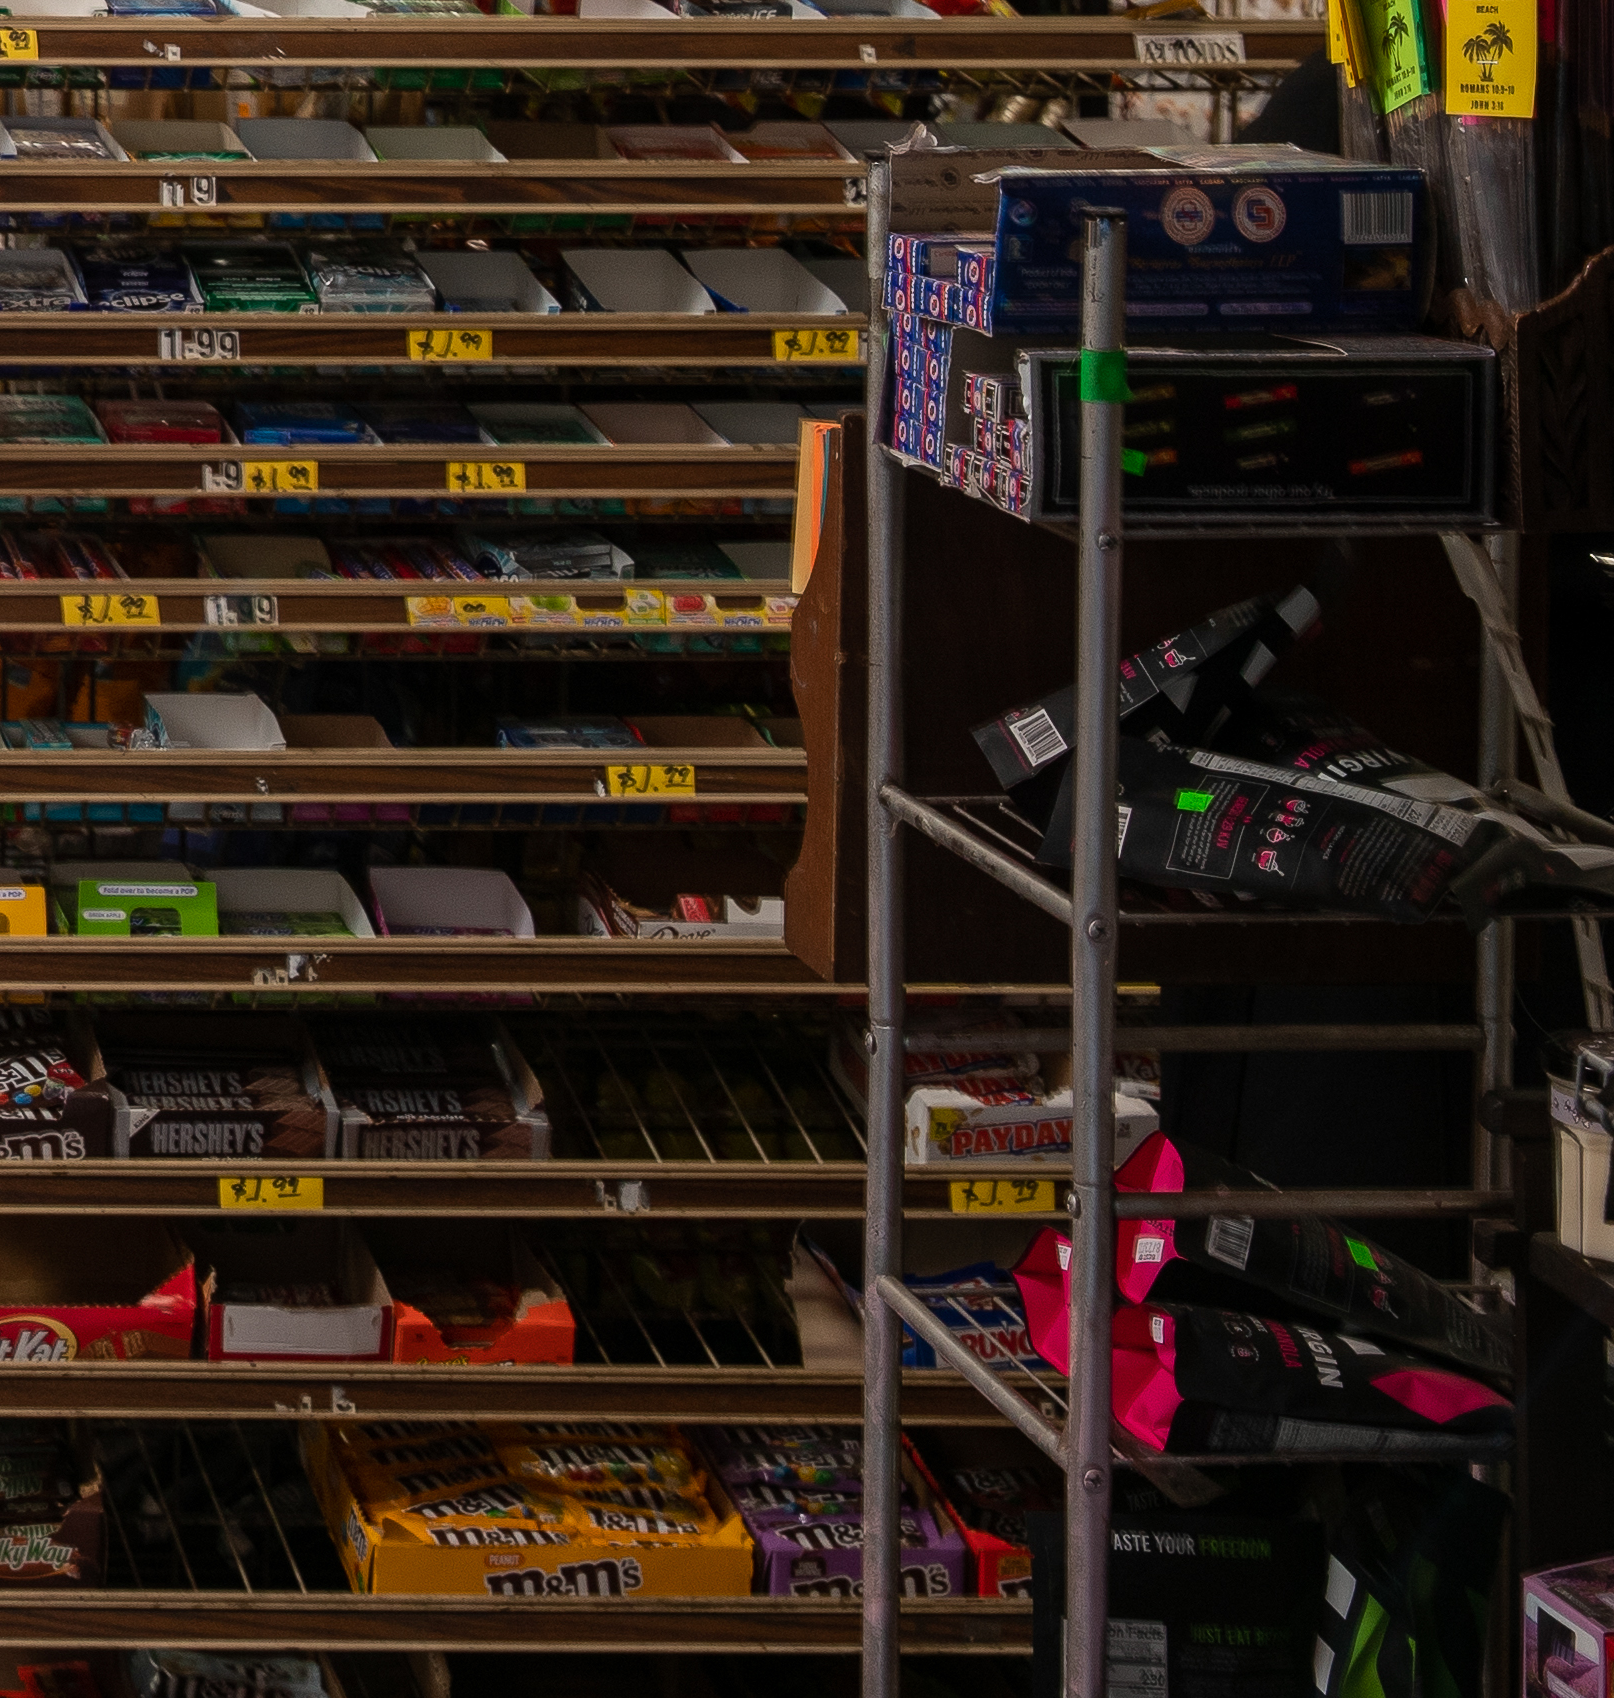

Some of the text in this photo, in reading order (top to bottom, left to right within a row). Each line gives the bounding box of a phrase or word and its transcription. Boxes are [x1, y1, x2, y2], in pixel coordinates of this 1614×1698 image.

[1476, 5, 1499, 14] BEACH
[1460, 84, 1489, 94] ROMANS
[1470, 100, 1489, 110] JOHN
[152, 1123, 264, 1157] HERSHEY'S
[950, 1121, 1072, 1157] PAYDAY
